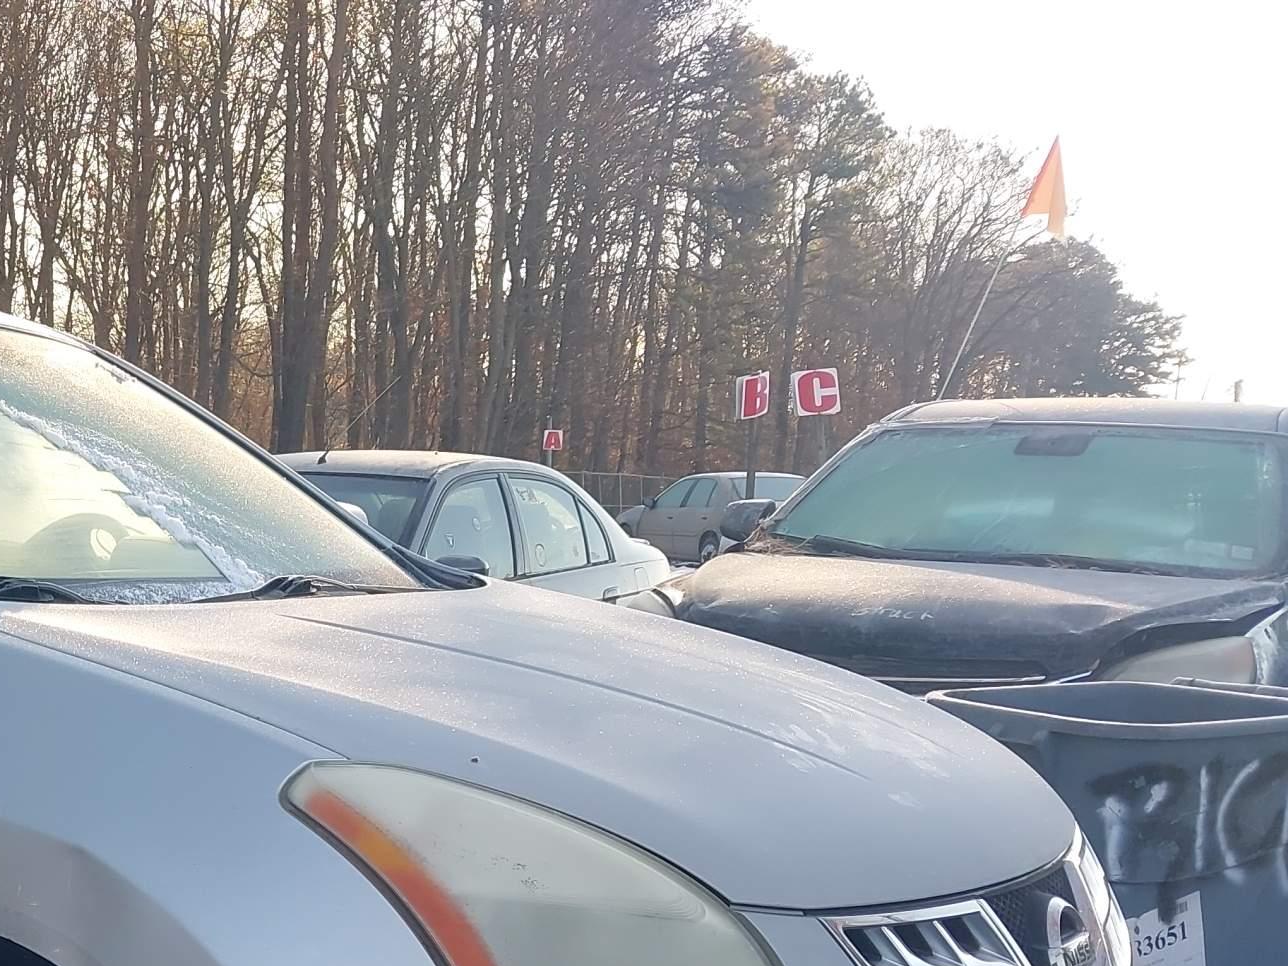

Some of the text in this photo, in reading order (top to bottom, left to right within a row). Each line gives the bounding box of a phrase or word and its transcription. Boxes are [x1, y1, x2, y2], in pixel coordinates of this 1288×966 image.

[743, 376, 768, 417] B
[798, 371, 838, 413] C
[544, 431, 562, 449] A
